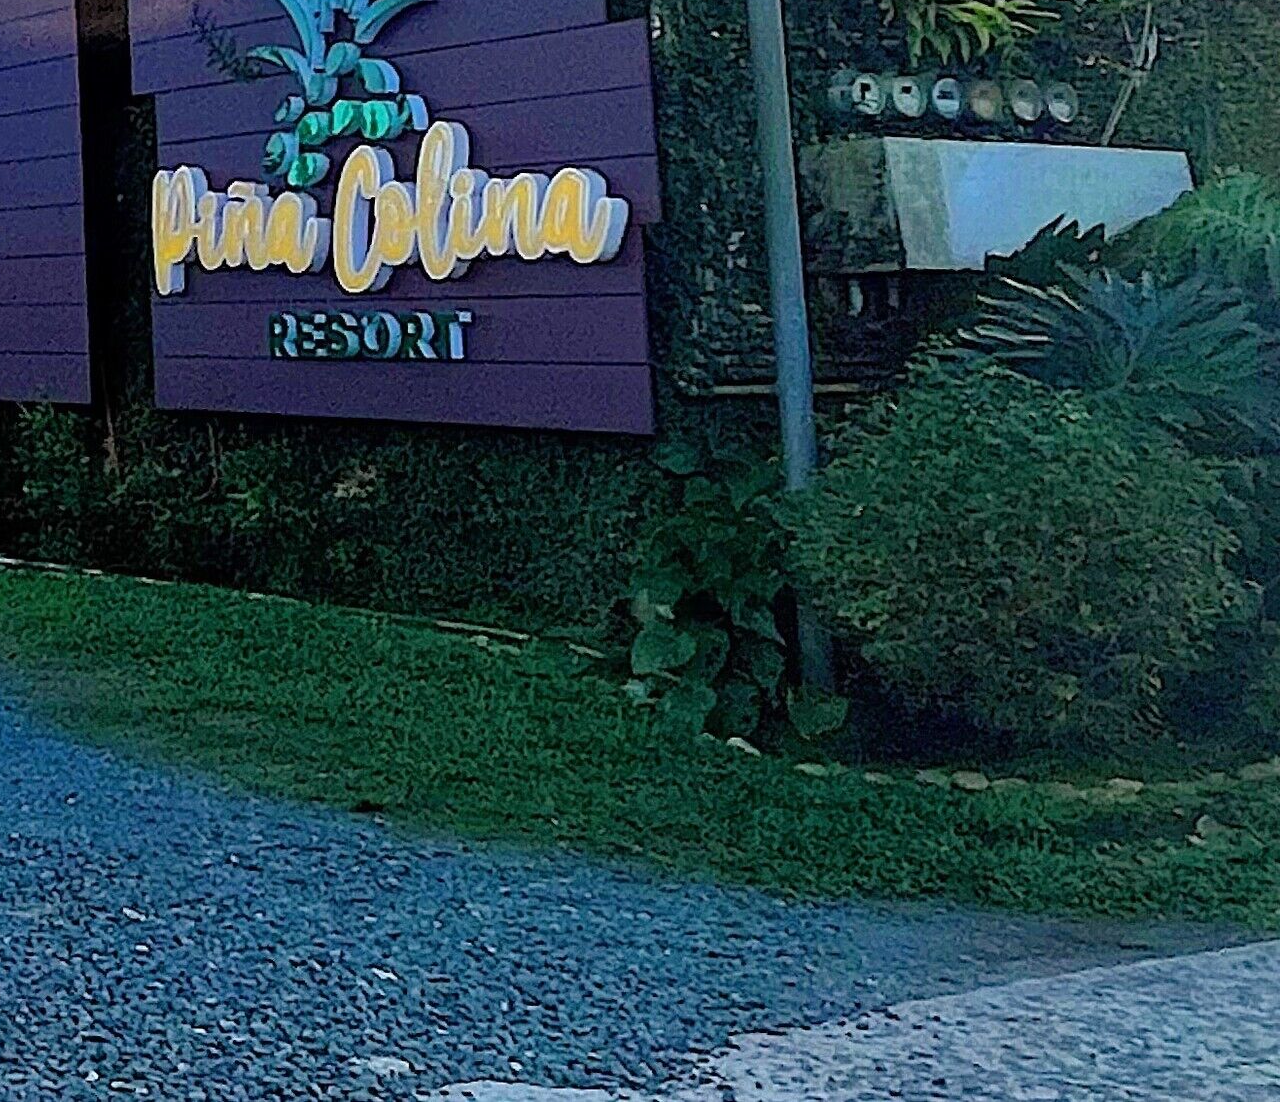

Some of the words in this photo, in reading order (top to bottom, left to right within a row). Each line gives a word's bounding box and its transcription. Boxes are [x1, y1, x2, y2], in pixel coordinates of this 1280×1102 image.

[152, 165, 331, 295] Piña
[334, 121, 629, 294] Colina
[269, 310, 473, 360] RESORT
